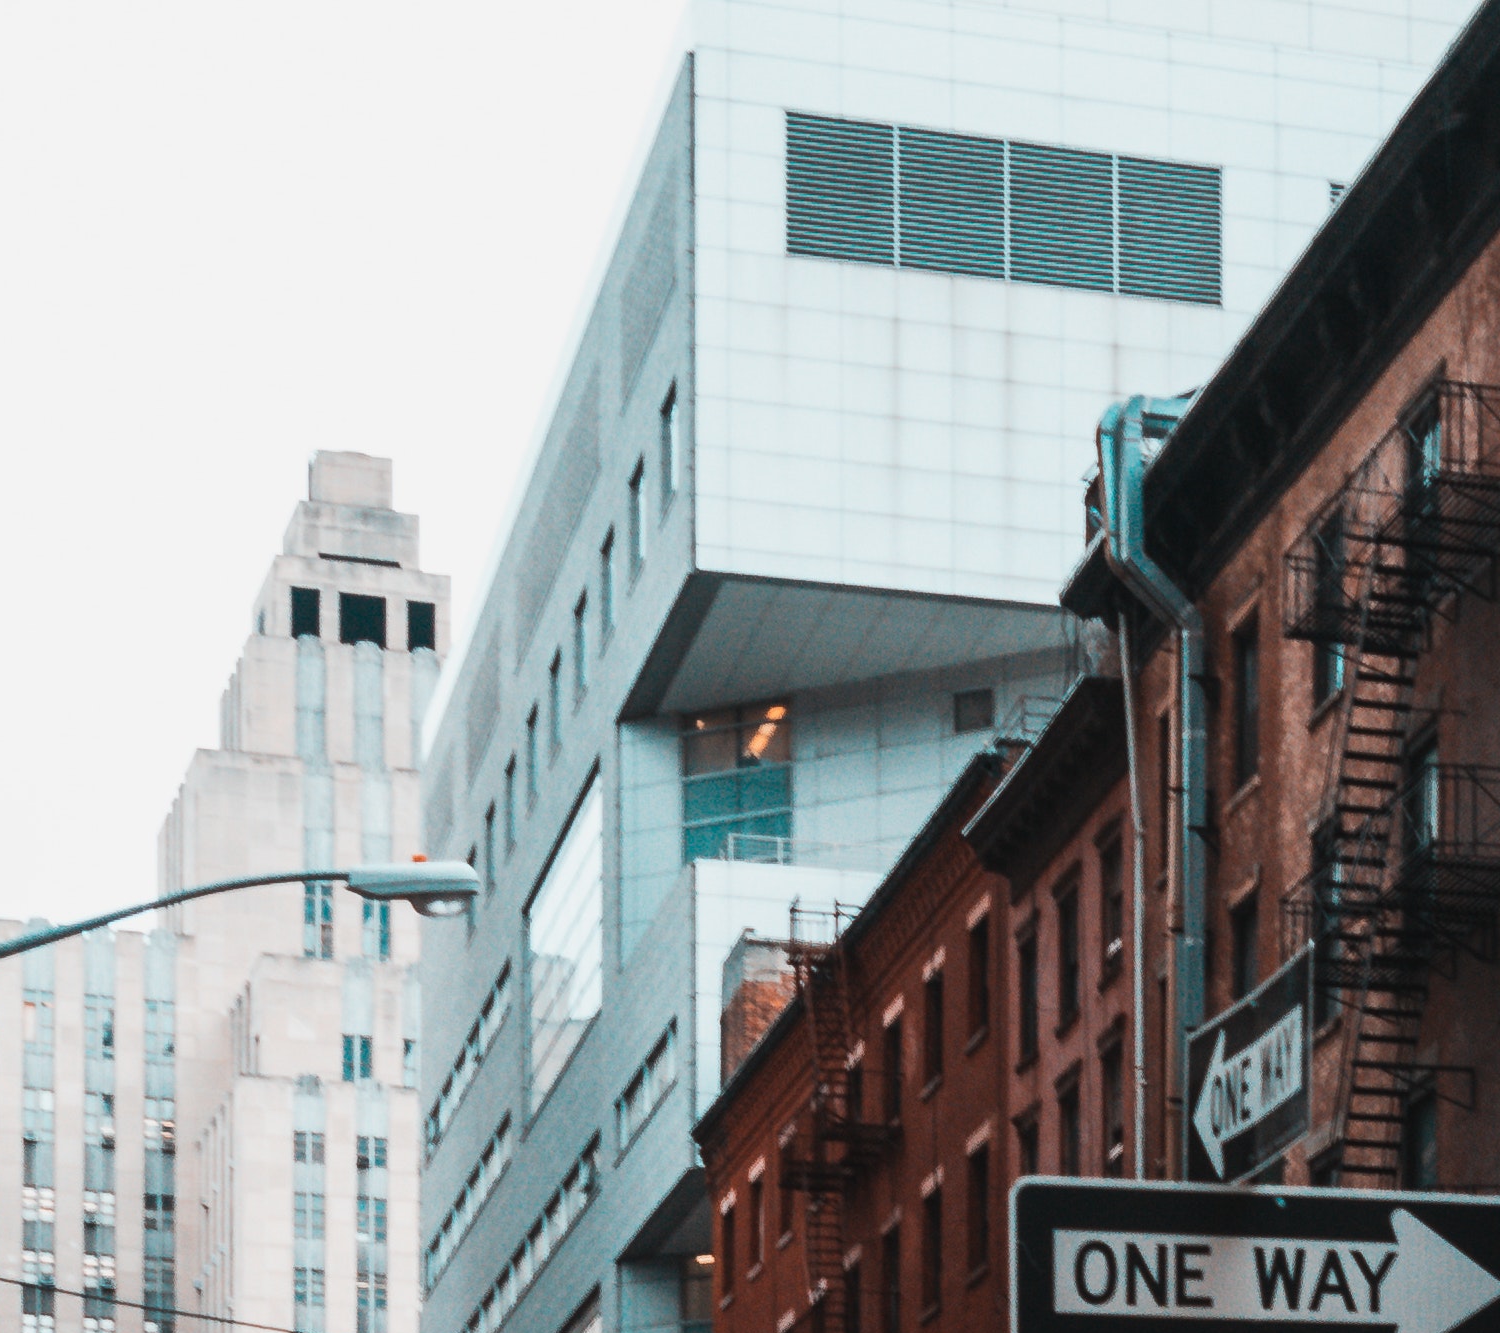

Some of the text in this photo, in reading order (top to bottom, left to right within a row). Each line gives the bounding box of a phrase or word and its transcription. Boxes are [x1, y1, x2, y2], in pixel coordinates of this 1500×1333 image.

[1211, 1018, 1296, 1138] ONE WAY
[1073, 1239, 1398, 1313] ONE WAY
